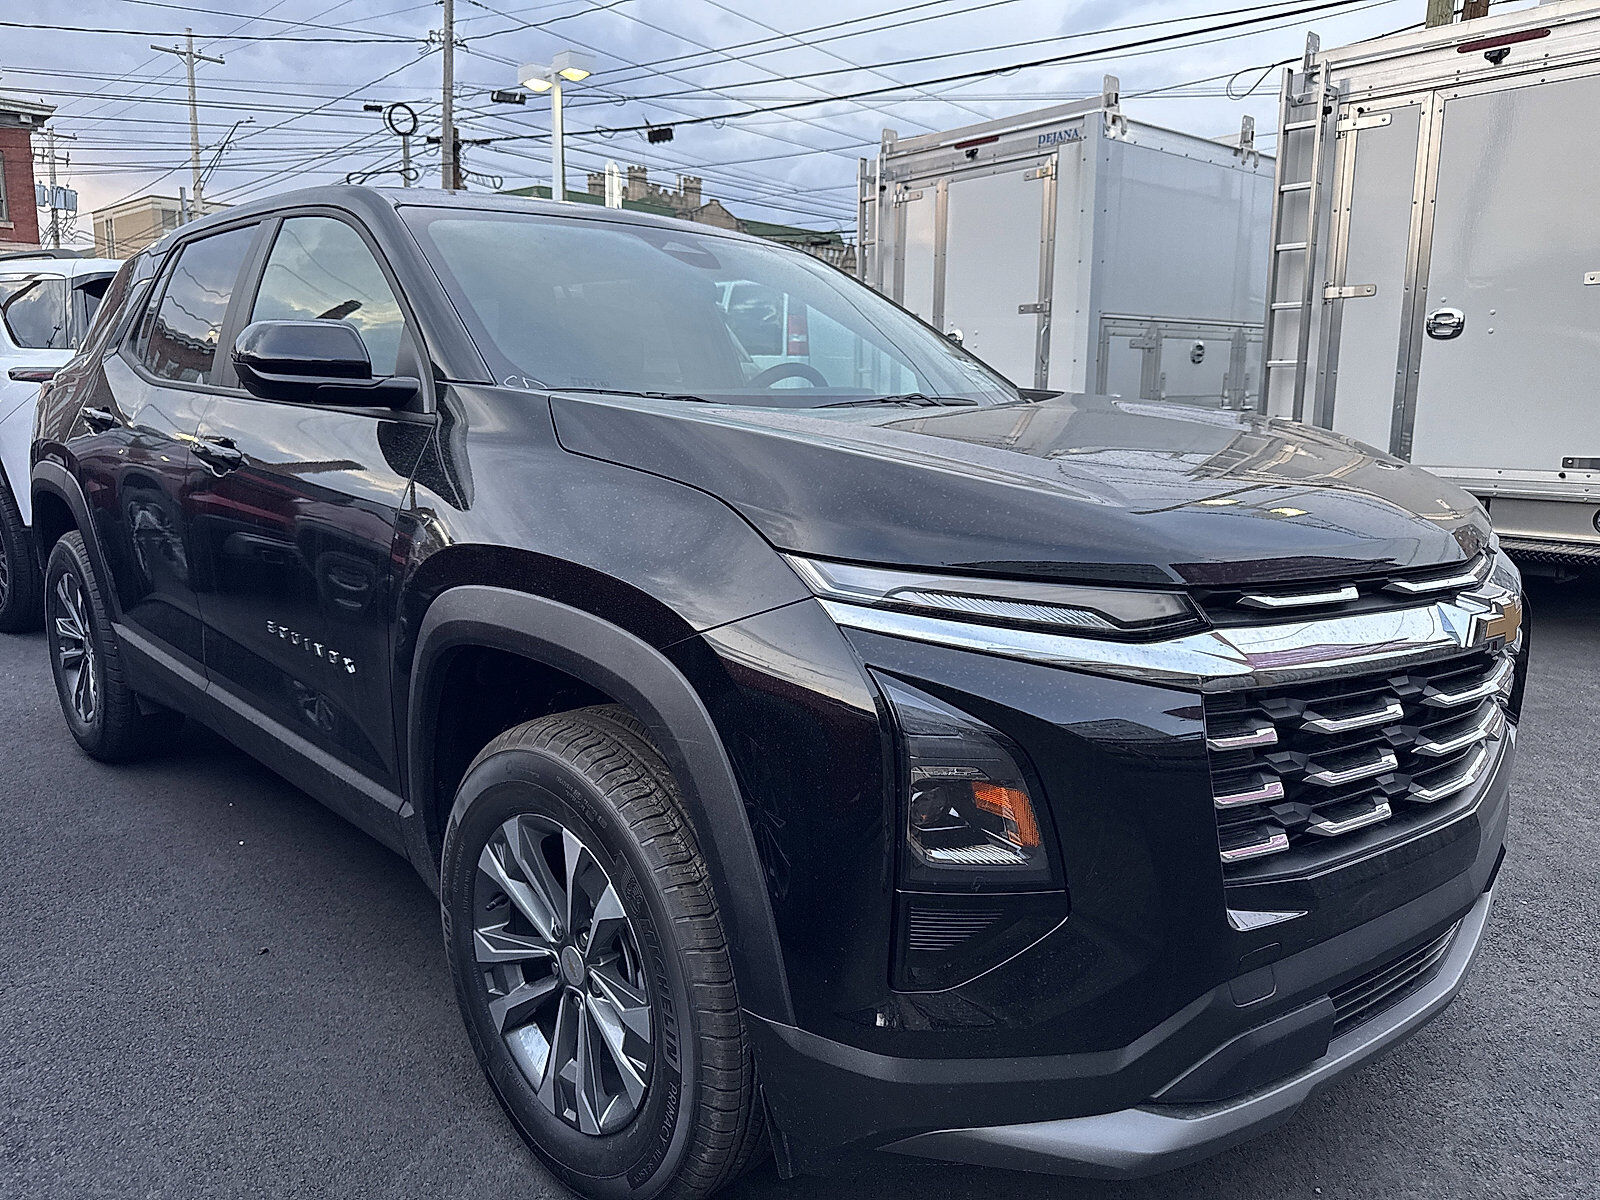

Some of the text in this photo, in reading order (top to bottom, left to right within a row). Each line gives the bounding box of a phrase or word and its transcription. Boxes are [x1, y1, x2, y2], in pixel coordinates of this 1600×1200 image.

[1038, 128, 1080, 145] DEJANA
[642, 922, 680, 1065] MICHELIN
[658, 1081, 678, 1147] PRIMACY
